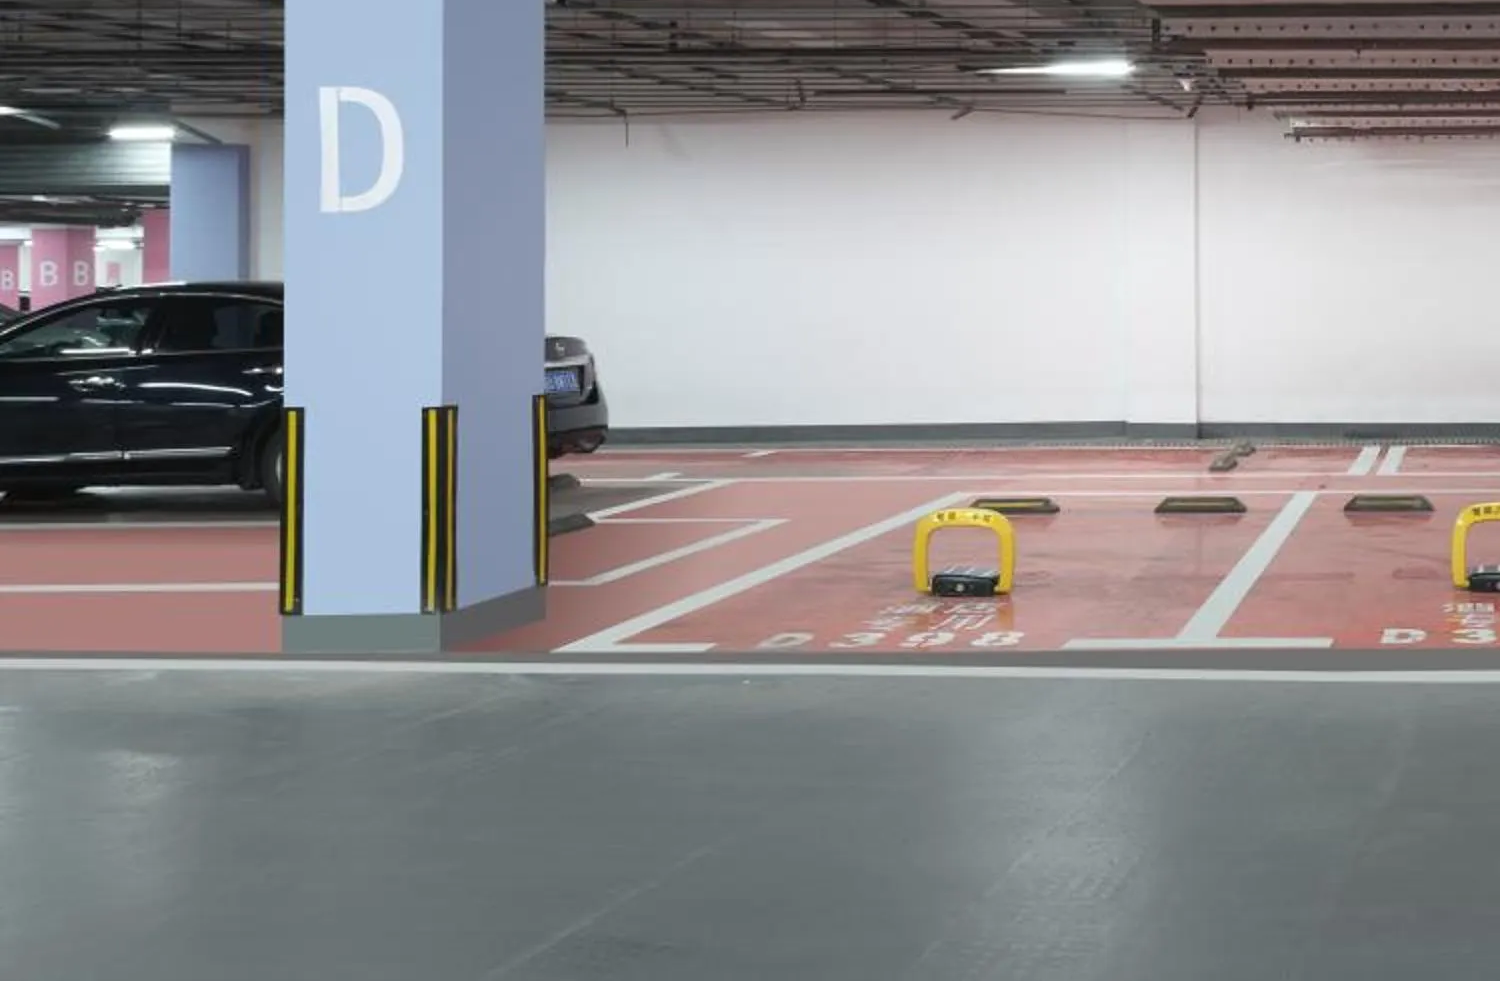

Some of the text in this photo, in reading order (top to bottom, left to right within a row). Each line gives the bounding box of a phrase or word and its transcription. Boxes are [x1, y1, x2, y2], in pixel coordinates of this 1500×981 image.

[319, 86, 404, 213] D
[40, 261, 58, 286] B
[73, 260, 88, 286] B
